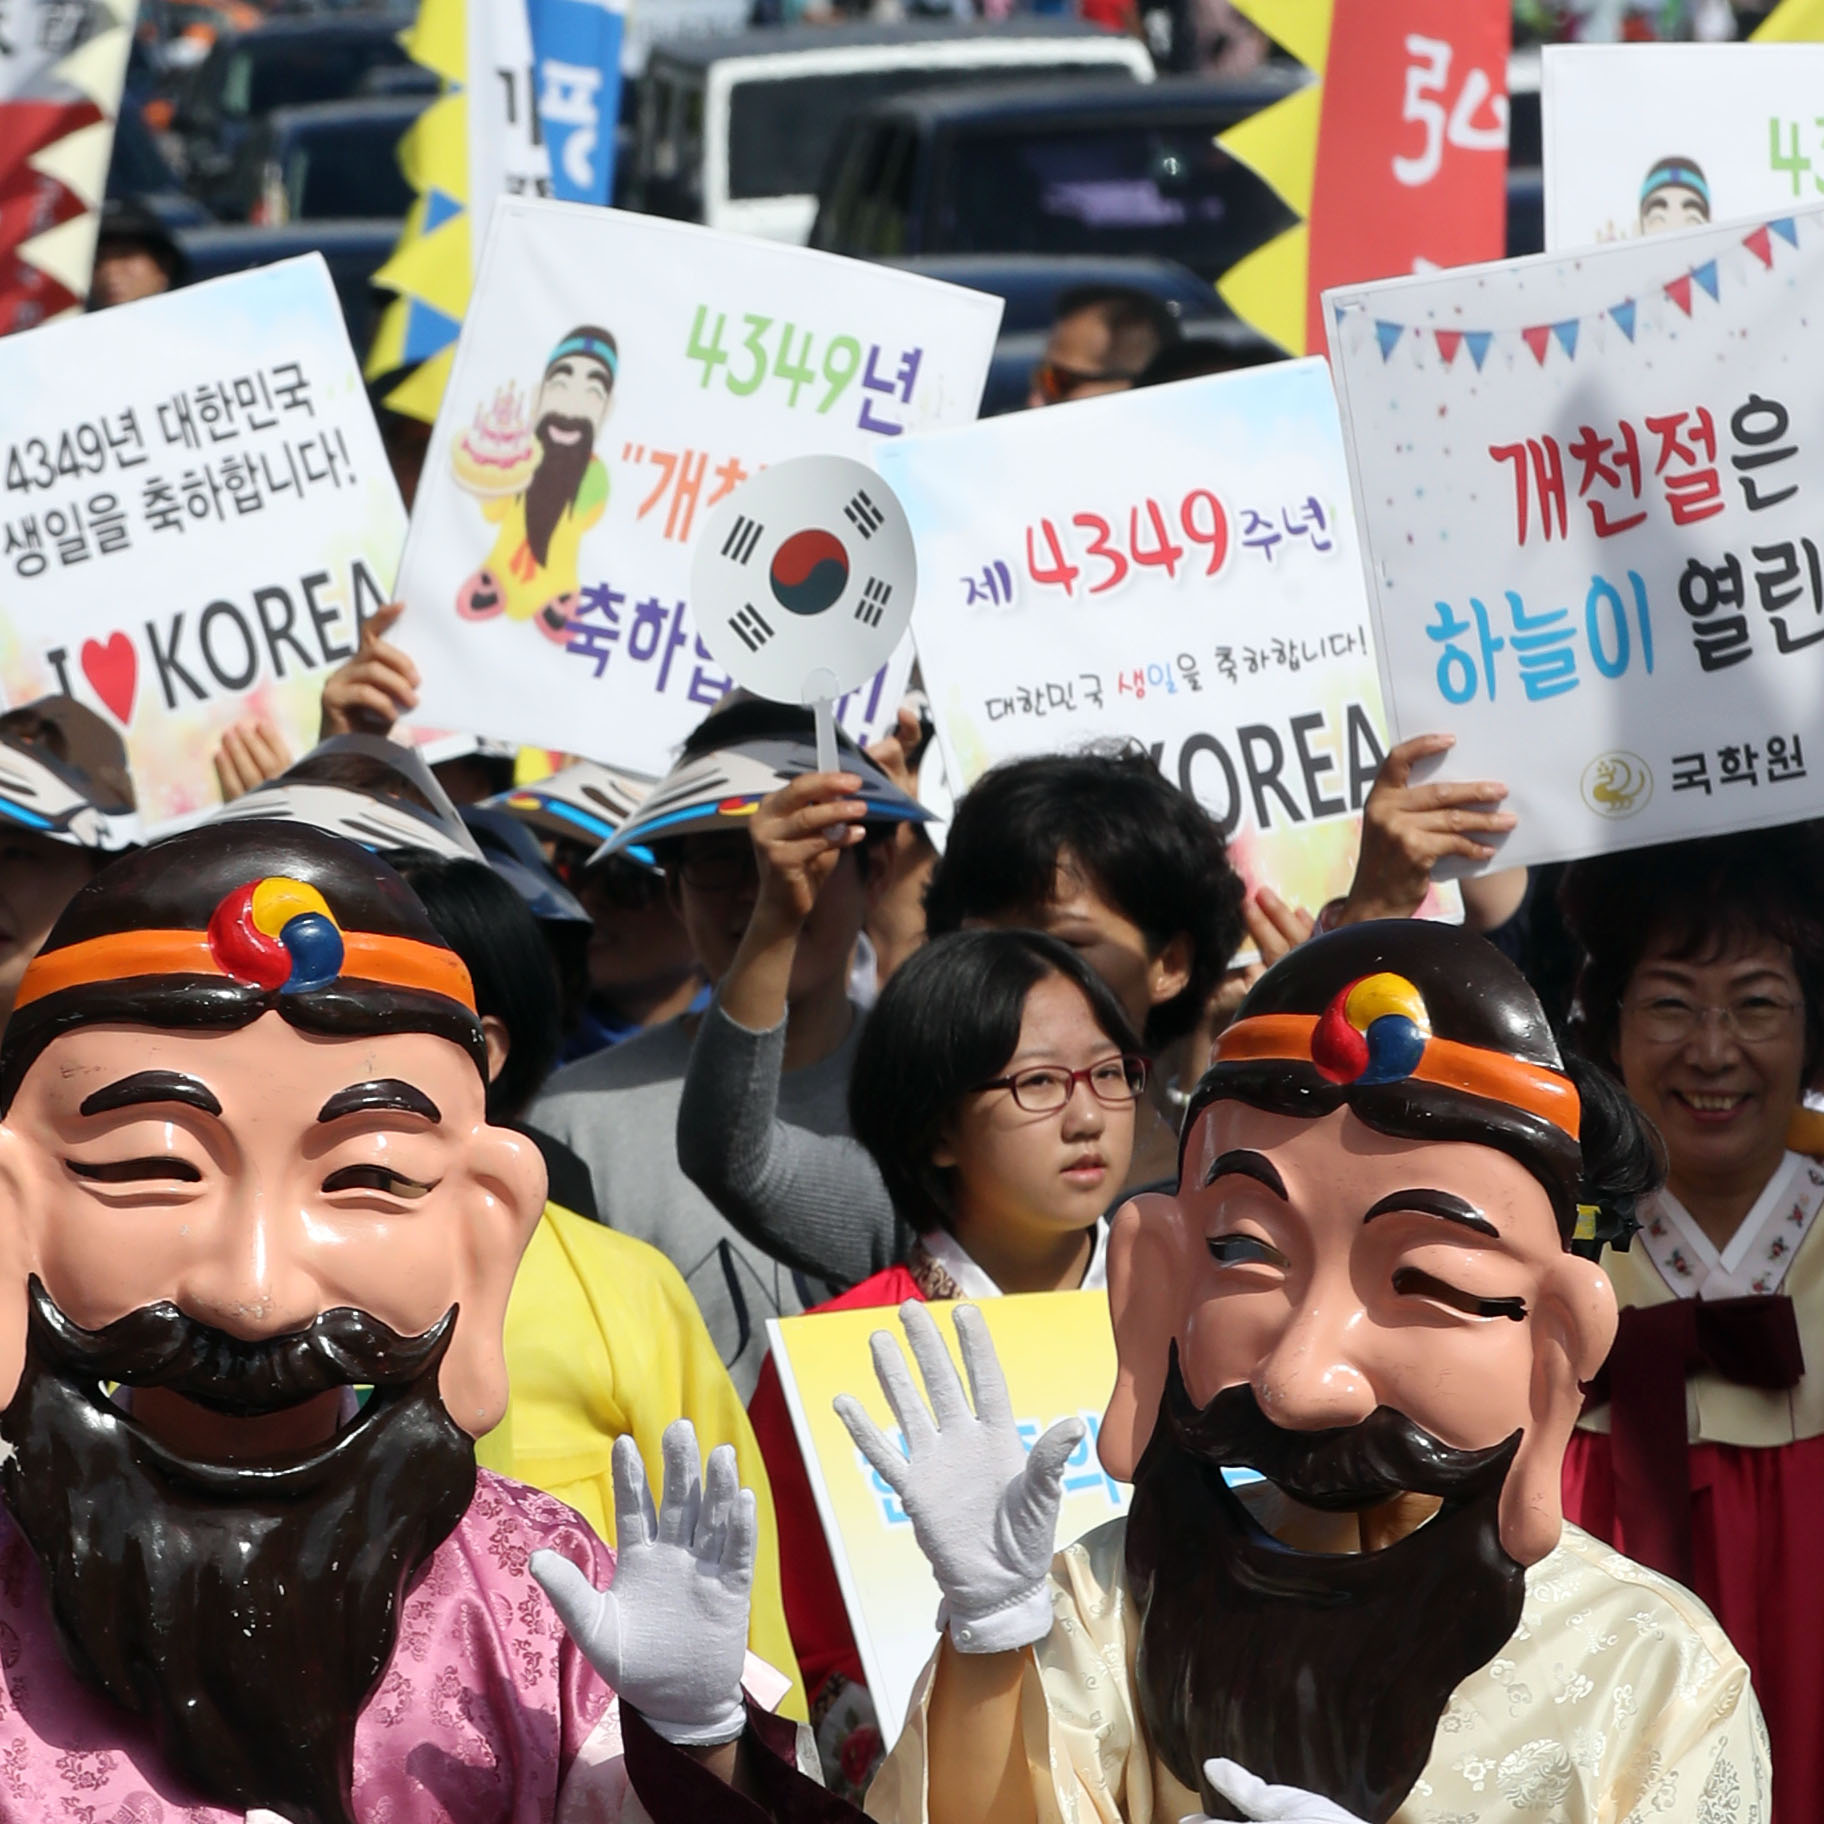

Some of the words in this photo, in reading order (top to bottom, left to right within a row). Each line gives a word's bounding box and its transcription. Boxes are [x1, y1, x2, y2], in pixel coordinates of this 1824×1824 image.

[4, 405, 149, 494] 4349년
[155, 361, 316, 450] 대한민국
[685, 304, 924, 436] 4349년
[3, 491, 133, 579] 생일을
[142, 426, 358, 535] 축하합니다!
[1488, 393, 1800, 547] 개천절은
[144, 560, 388, 711] KOREA
[984, 673, 1105, 722] 대한민국
[1117, 652, 1203, 700] 생일을
[1213, 624, 1369, 685] 축하합니다!
[1425, 569, 1655, 705] 하늘이
[1678, 537, 1824, 674] 열린
[1146, 702, 1388, 844] OREA
[1671, 733, 1808, 796] 국학원
